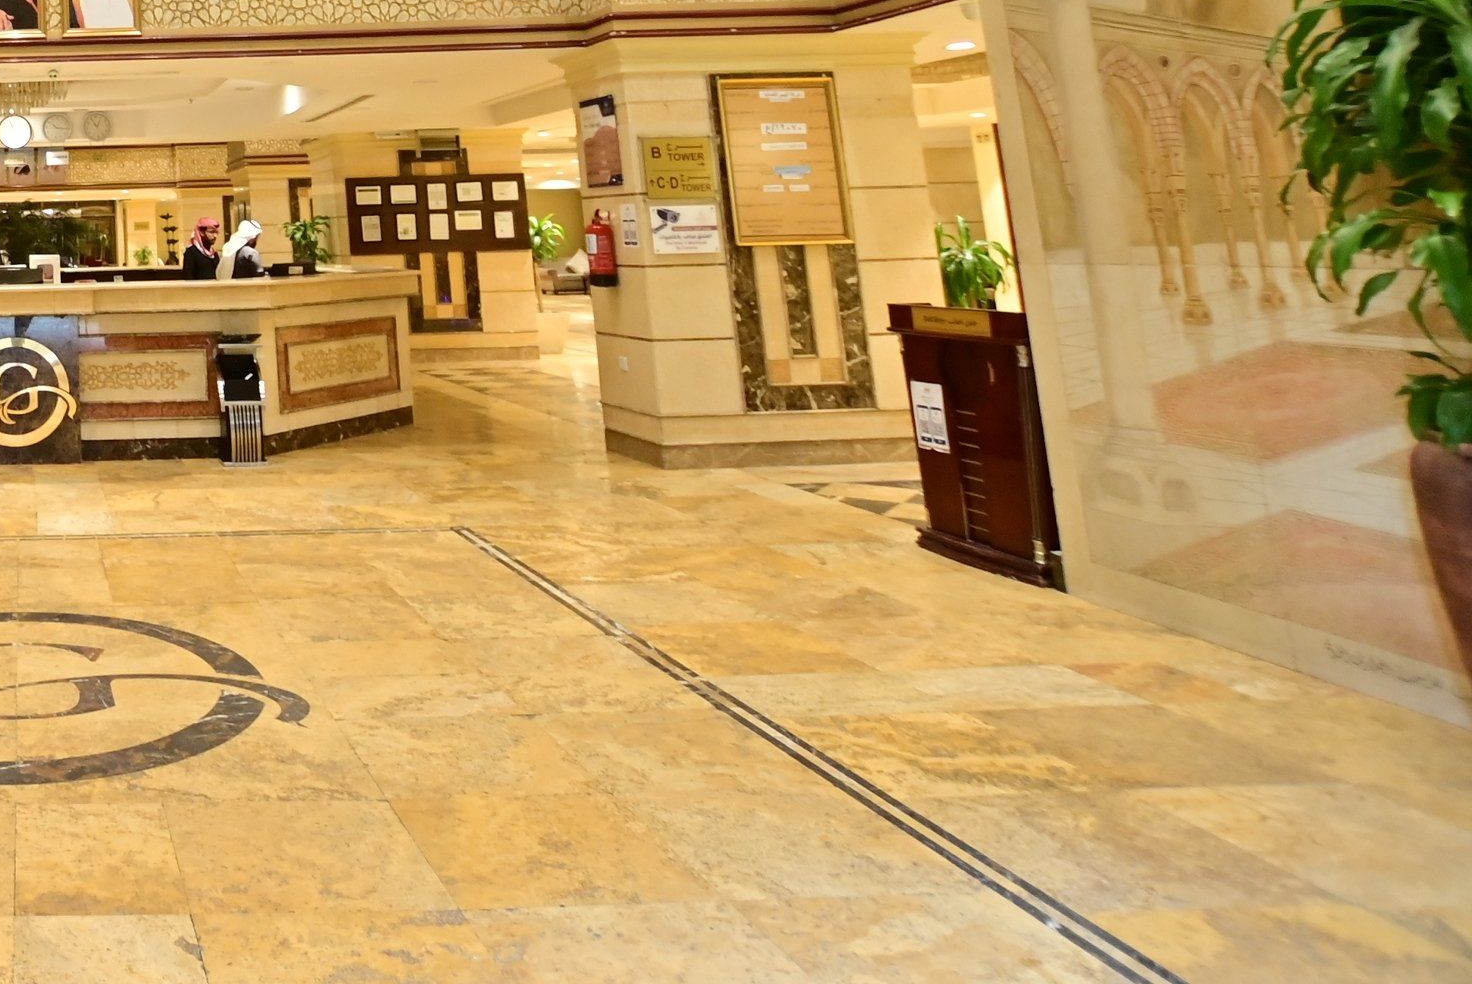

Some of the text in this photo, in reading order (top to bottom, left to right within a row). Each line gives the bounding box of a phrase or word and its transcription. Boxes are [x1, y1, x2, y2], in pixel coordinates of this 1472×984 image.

[651, 146, 705, 161] B TOWER
[681, 184, 712, 192] TOWER
